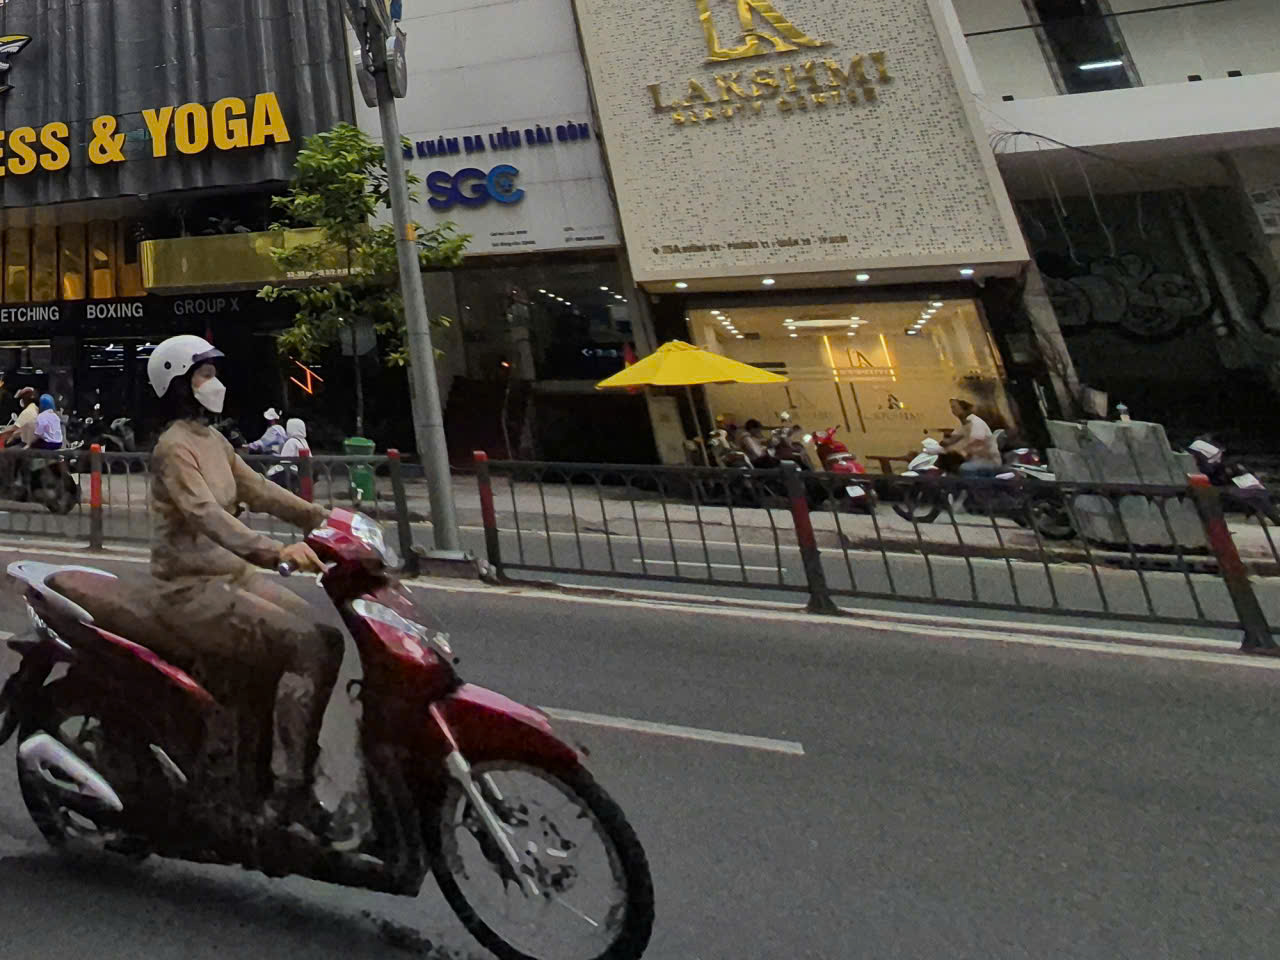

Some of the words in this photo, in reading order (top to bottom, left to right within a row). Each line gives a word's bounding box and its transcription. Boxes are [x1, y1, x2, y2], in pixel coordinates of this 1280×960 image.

[646, 50, 893, 113] LAKSHMI
[88, 113, 125, 166] &
[141, 90, 291, 158] YOGA
[425, 164, 526, 209] SGC
[86, 301, 144, 320] BOXING
[173, 297, 226, 316] GROUP
[229, 296, 240, 312] X
